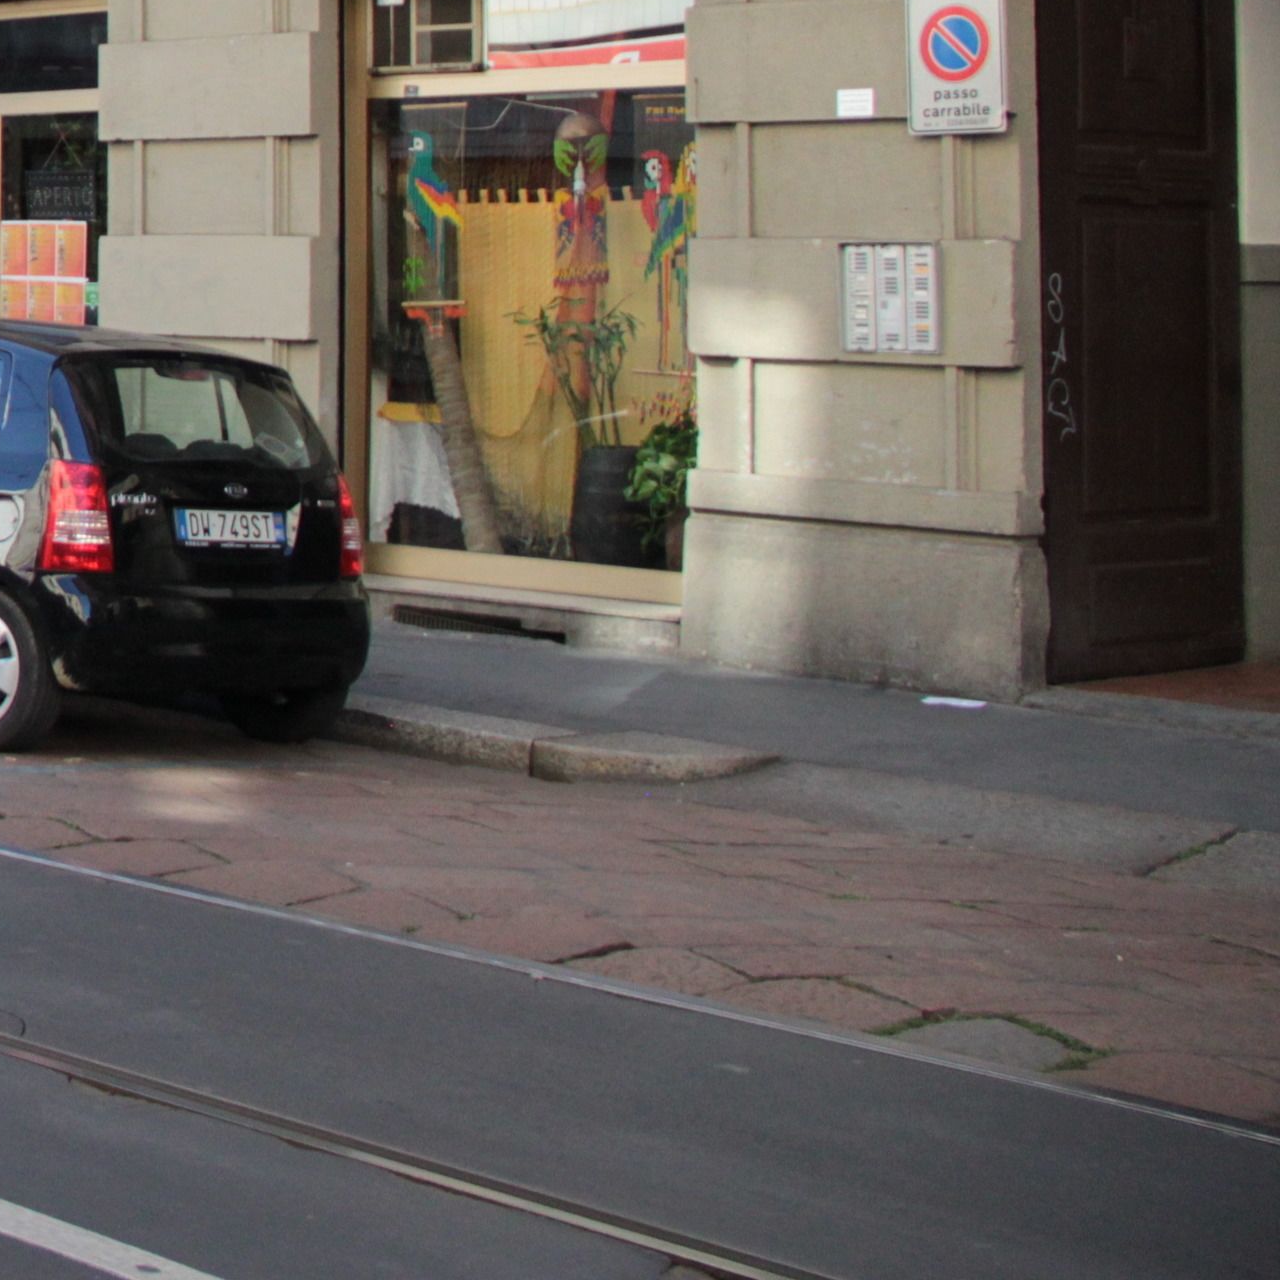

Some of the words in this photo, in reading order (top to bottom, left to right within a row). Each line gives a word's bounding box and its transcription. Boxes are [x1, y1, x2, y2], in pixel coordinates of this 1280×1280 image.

[933, 87, 979, 102] passo
[922, 102, 991, 118] carrabile
[33, 186, 92, 208] APERTO
[188, 511, 212, 538] DW
[217, 514, 272, 539] 749ST
